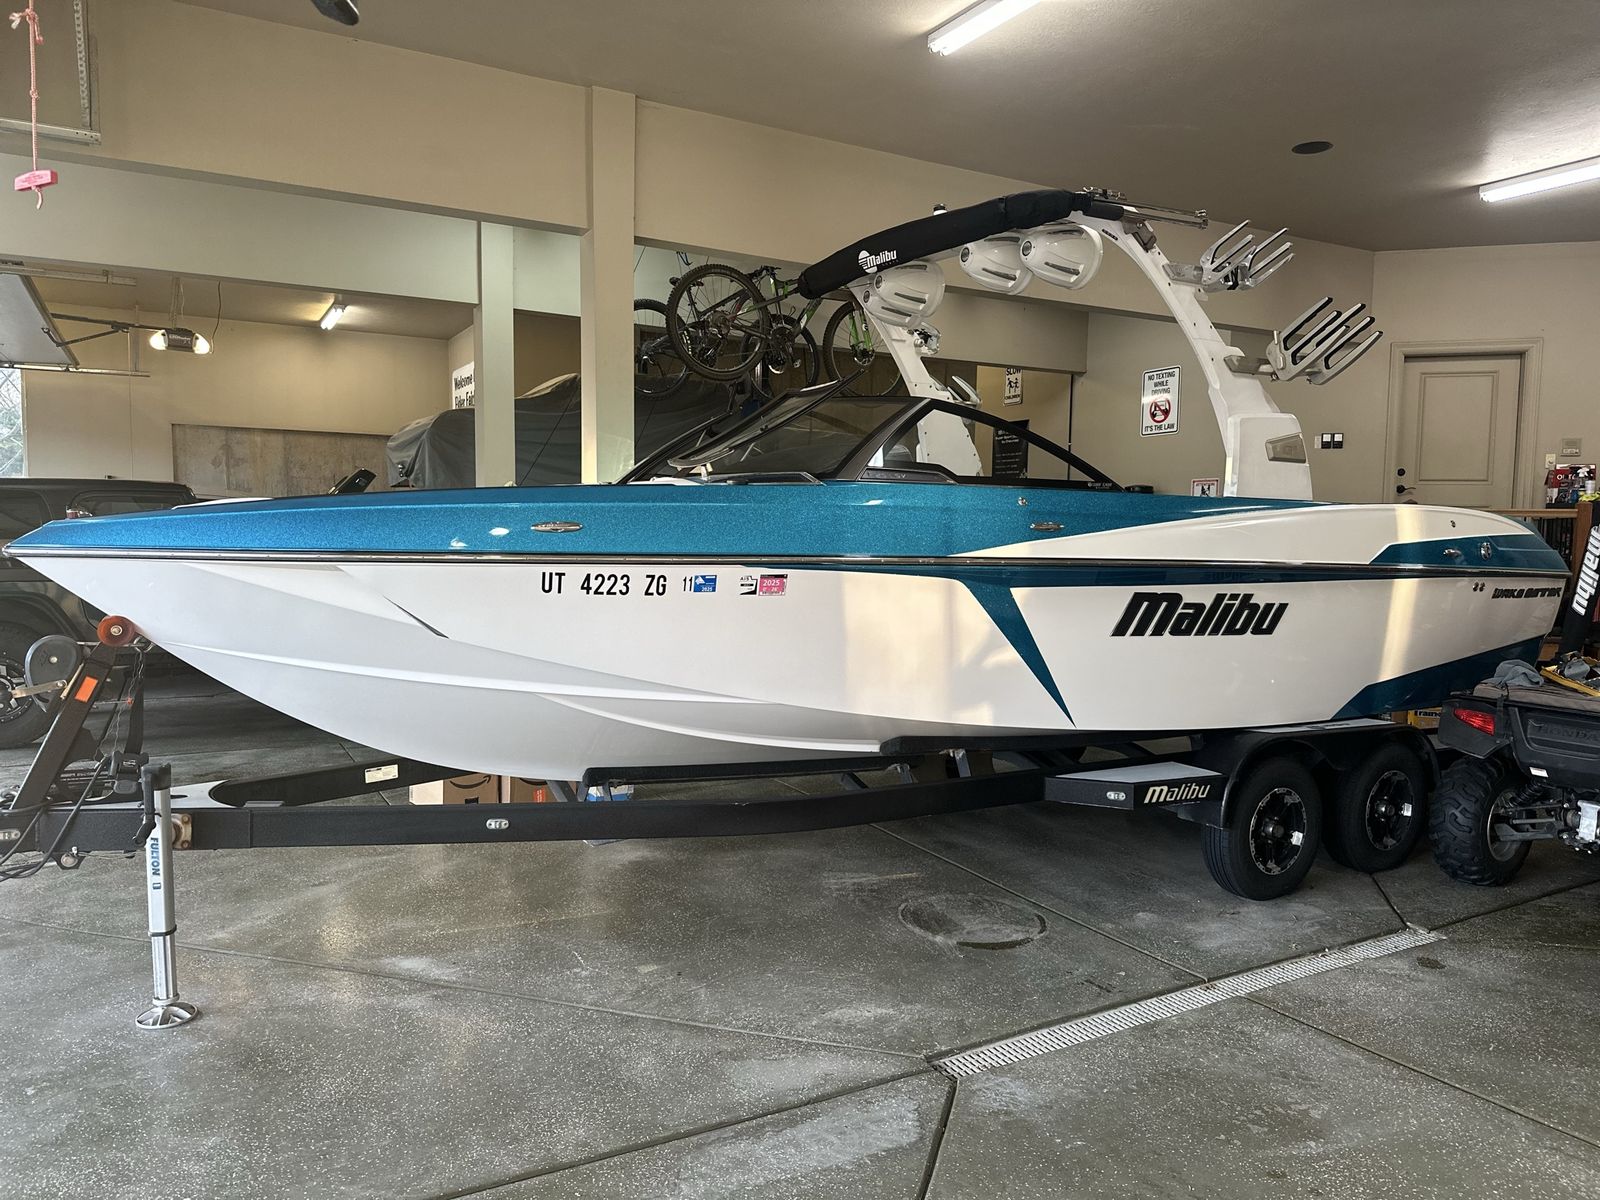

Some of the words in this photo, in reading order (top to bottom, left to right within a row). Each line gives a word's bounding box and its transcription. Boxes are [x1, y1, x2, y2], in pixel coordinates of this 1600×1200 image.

[866, 250, 897, 268] Malibu
[1156, 371, 1176, 380] TEXTING
[1152, 388, 1171, 396] DRIVING
[541, 571, 566, 595] UT
[580, 573, 631, 596] 4223
[644, 574, 668, 597] ZG
[683, 576, 693, 592] 11
[763, 579, 780, 587] 2025
[1110, 592, 1289, 637] Malibu
[1143, 782, 1211, 804] Malibu
[150, 837, 161, 876] FULTON
